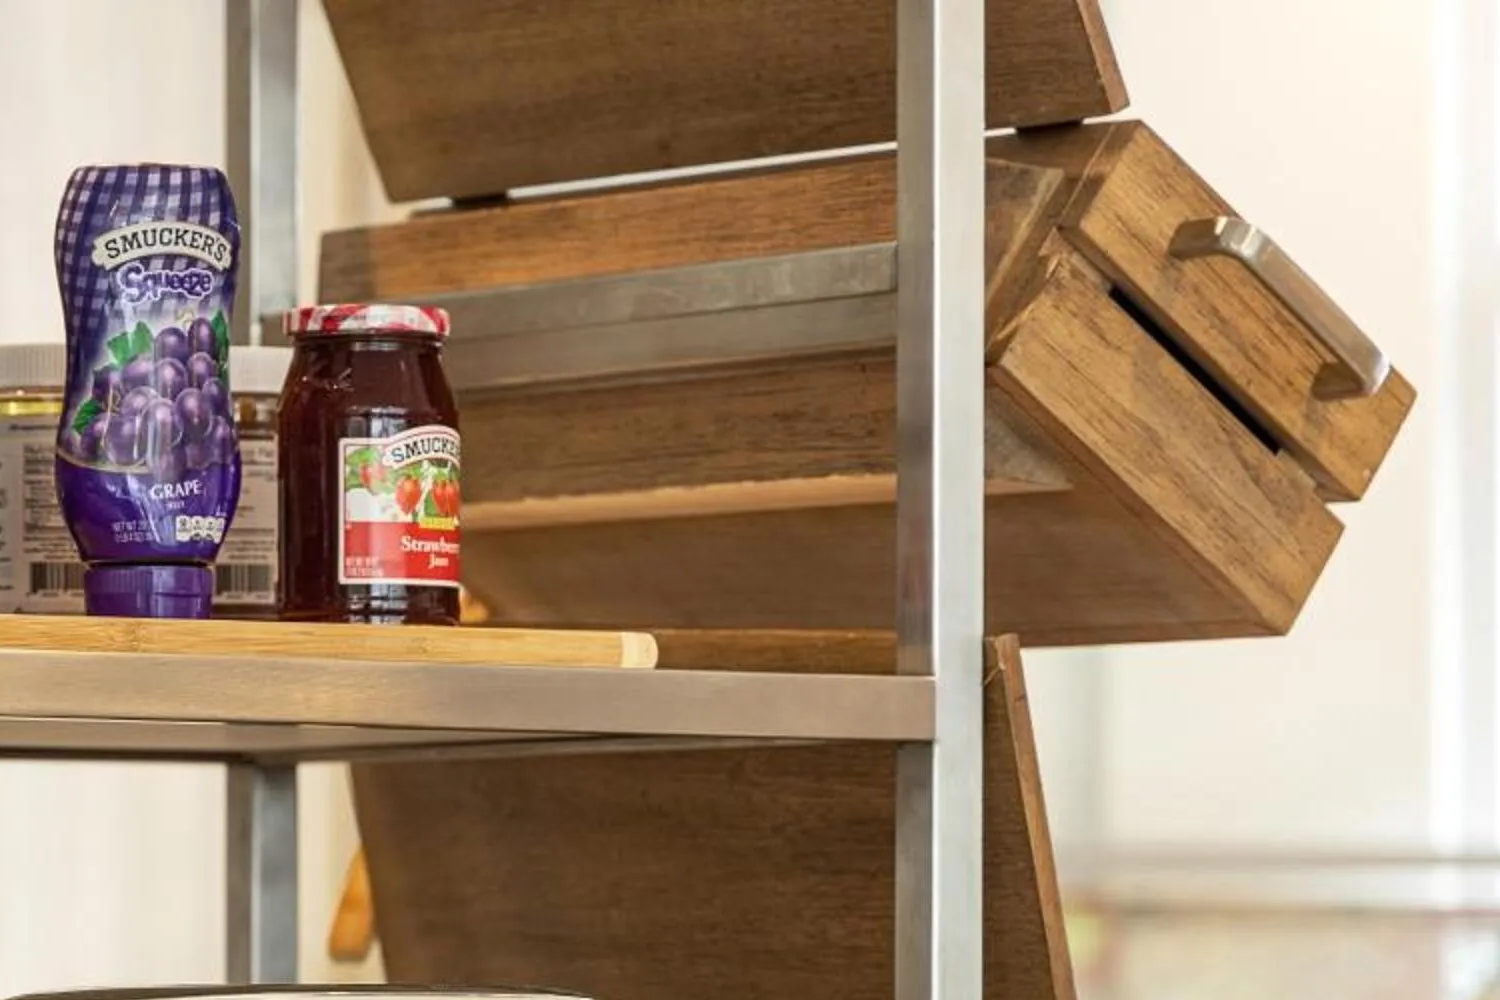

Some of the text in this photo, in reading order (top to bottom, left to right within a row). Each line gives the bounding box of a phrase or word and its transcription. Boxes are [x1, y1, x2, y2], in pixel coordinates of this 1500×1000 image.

[104, 227, 228, 262] SMUCKER'S
[117, 262, 213, 303] Squeeze
[149, 479, 203, 500] GRAPE
